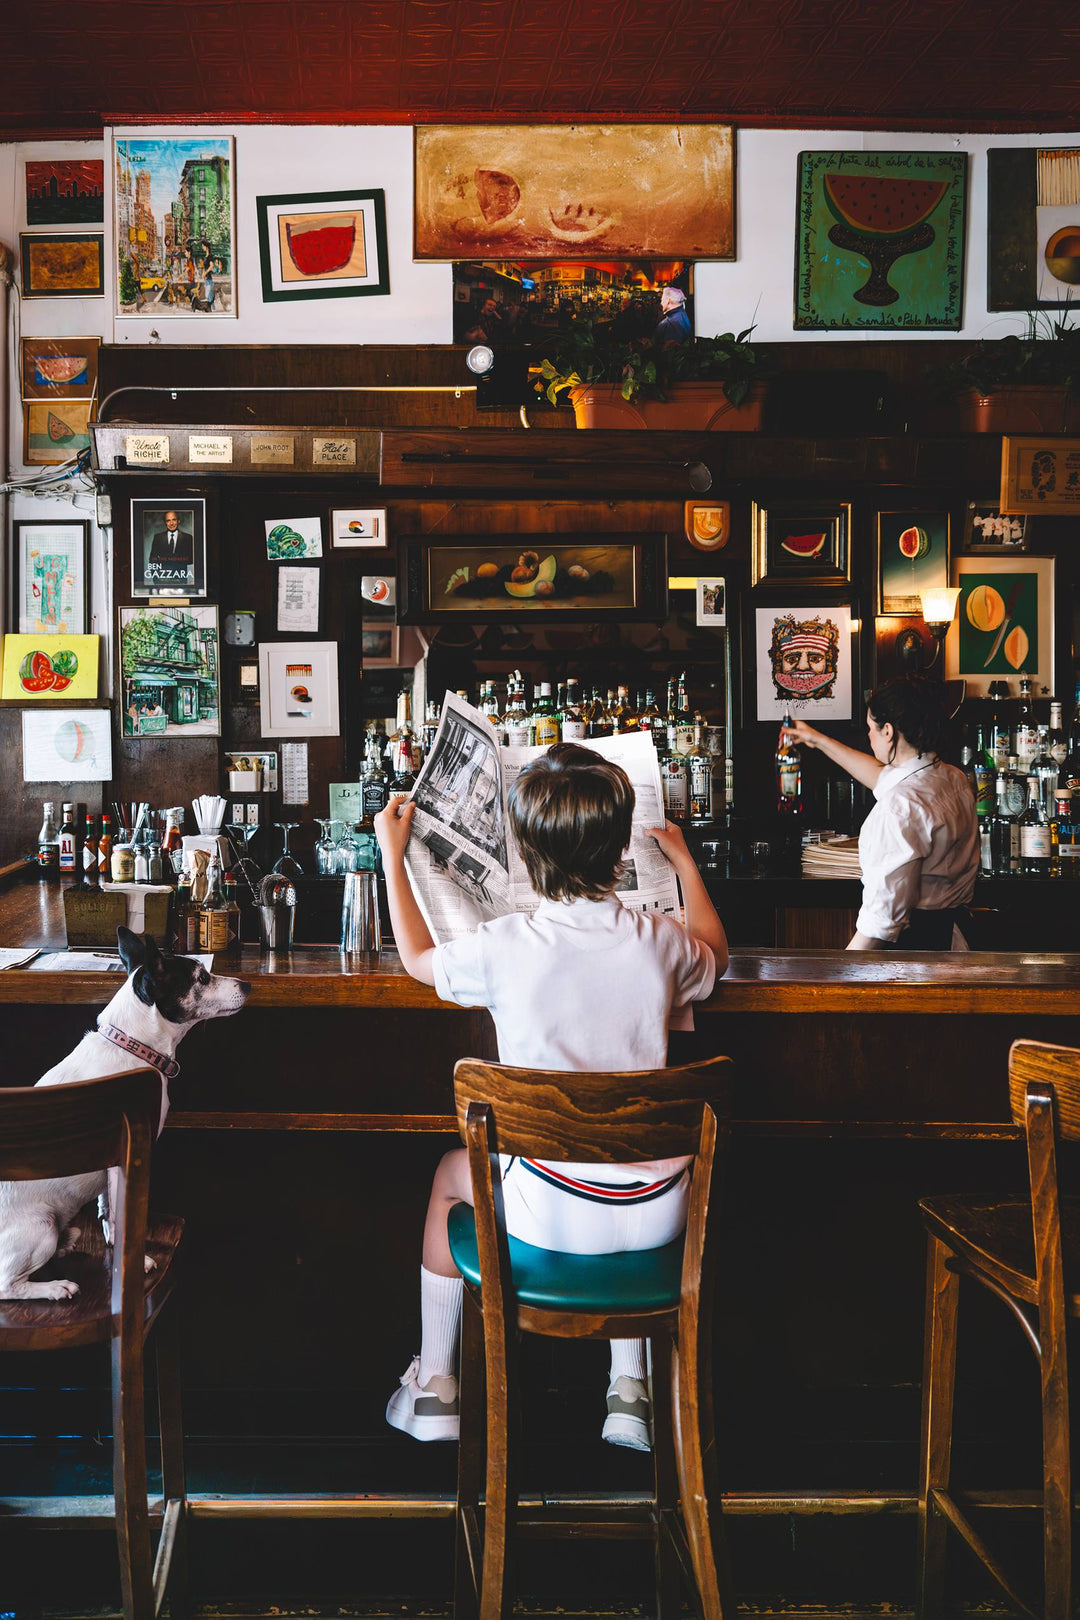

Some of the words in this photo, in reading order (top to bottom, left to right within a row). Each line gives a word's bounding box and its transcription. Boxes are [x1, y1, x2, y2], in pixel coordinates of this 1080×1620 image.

[830, 317, 838, 326] a
[134, 439, 161, 451] Uncle
[133, 450, 162, 459] RICHIE
[144, 569, 194, 579] GAZZARA
